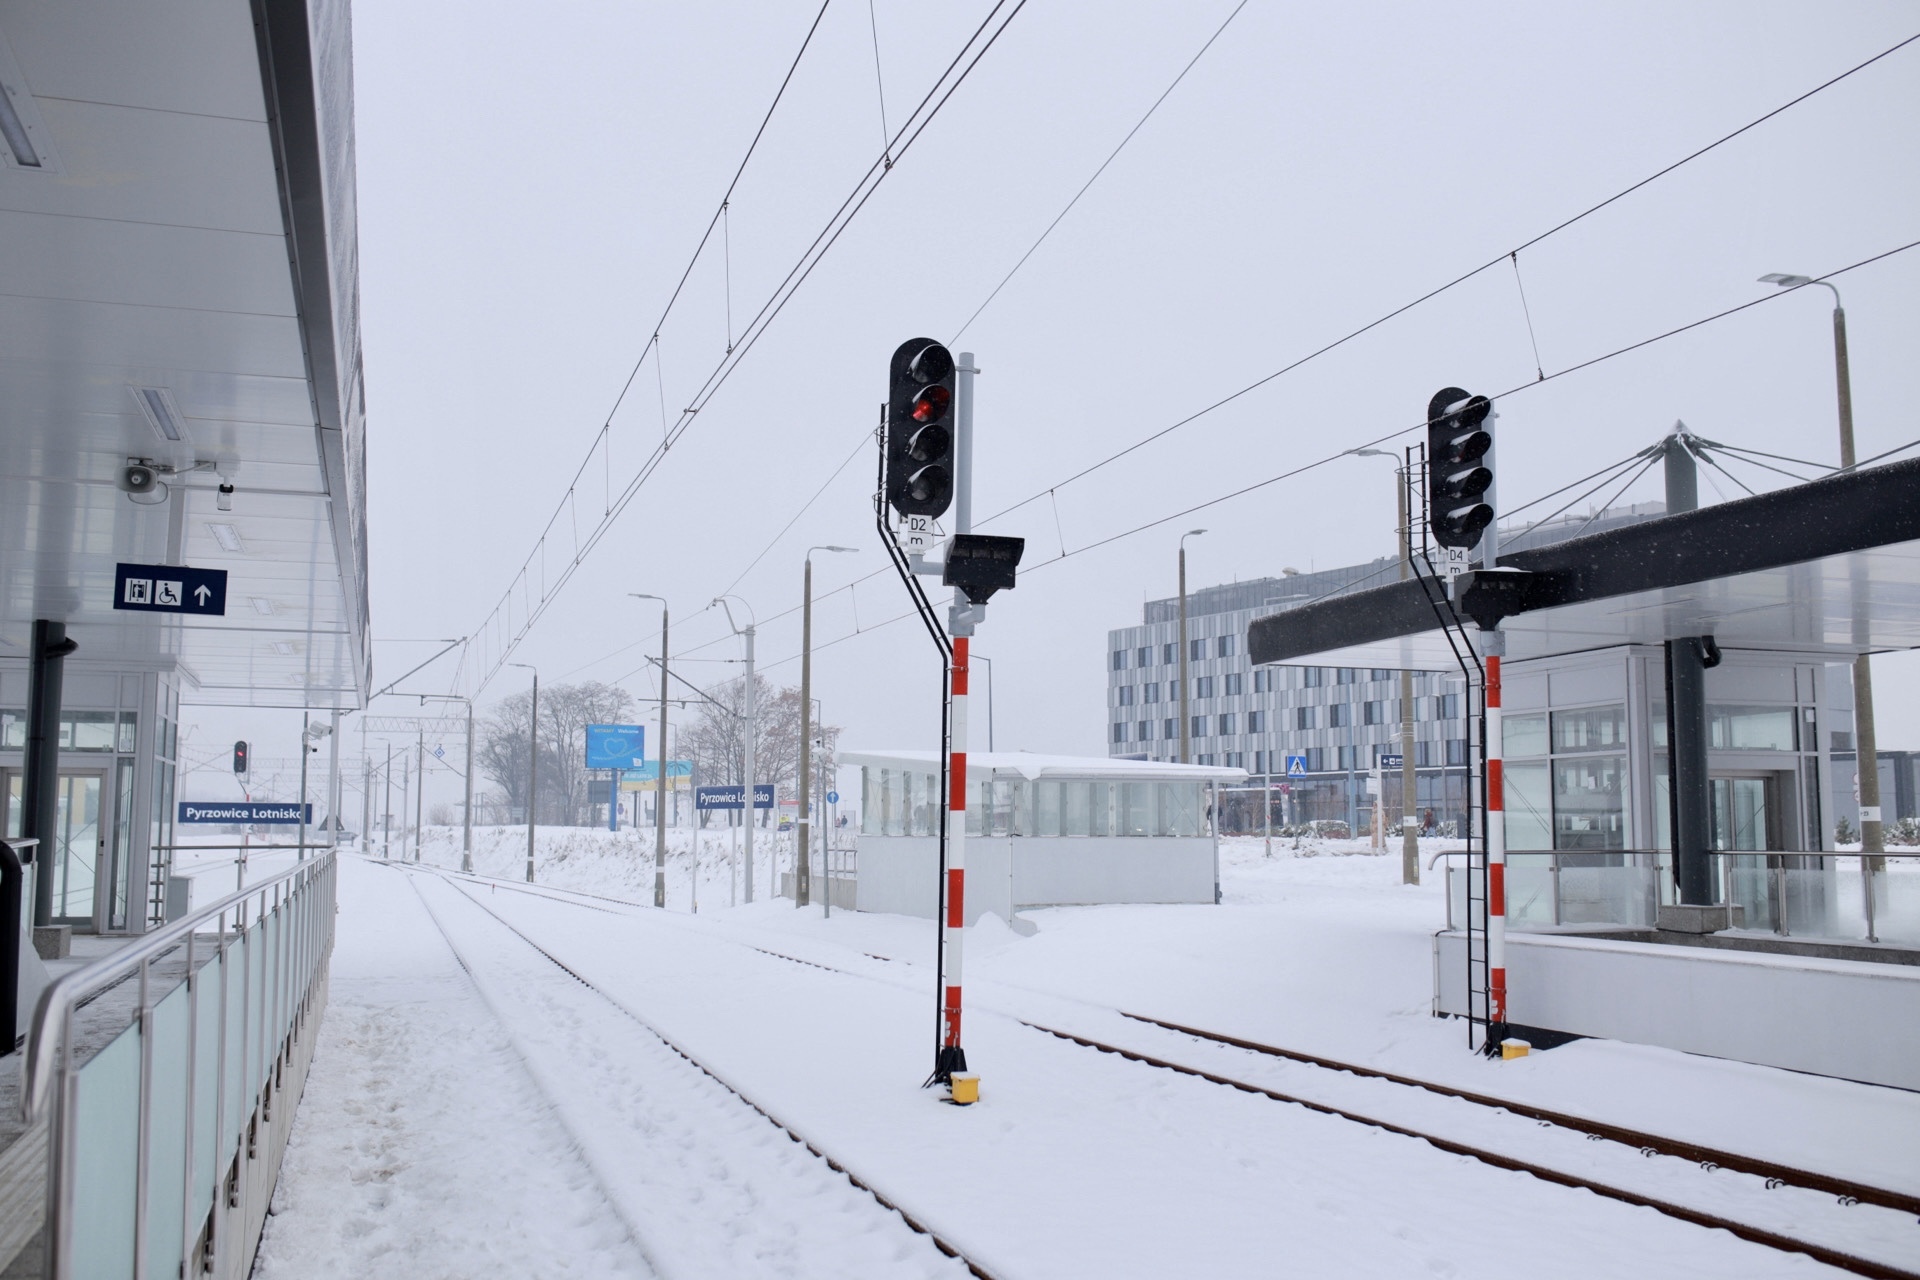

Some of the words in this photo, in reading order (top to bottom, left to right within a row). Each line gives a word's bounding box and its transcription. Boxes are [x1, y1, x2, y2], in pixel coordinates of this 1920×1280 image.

[911, 517, 926, 531] D2
[910, 537, 923, 545] m
[1450, 549, 1463, 561] D4
[1450, 566, 1461, 574] m
[700, 791, 736, 806] Pyrzowice
[737, 790, 770, 803] Loisko
[186, 807, 249, 820] Pyrzowice
